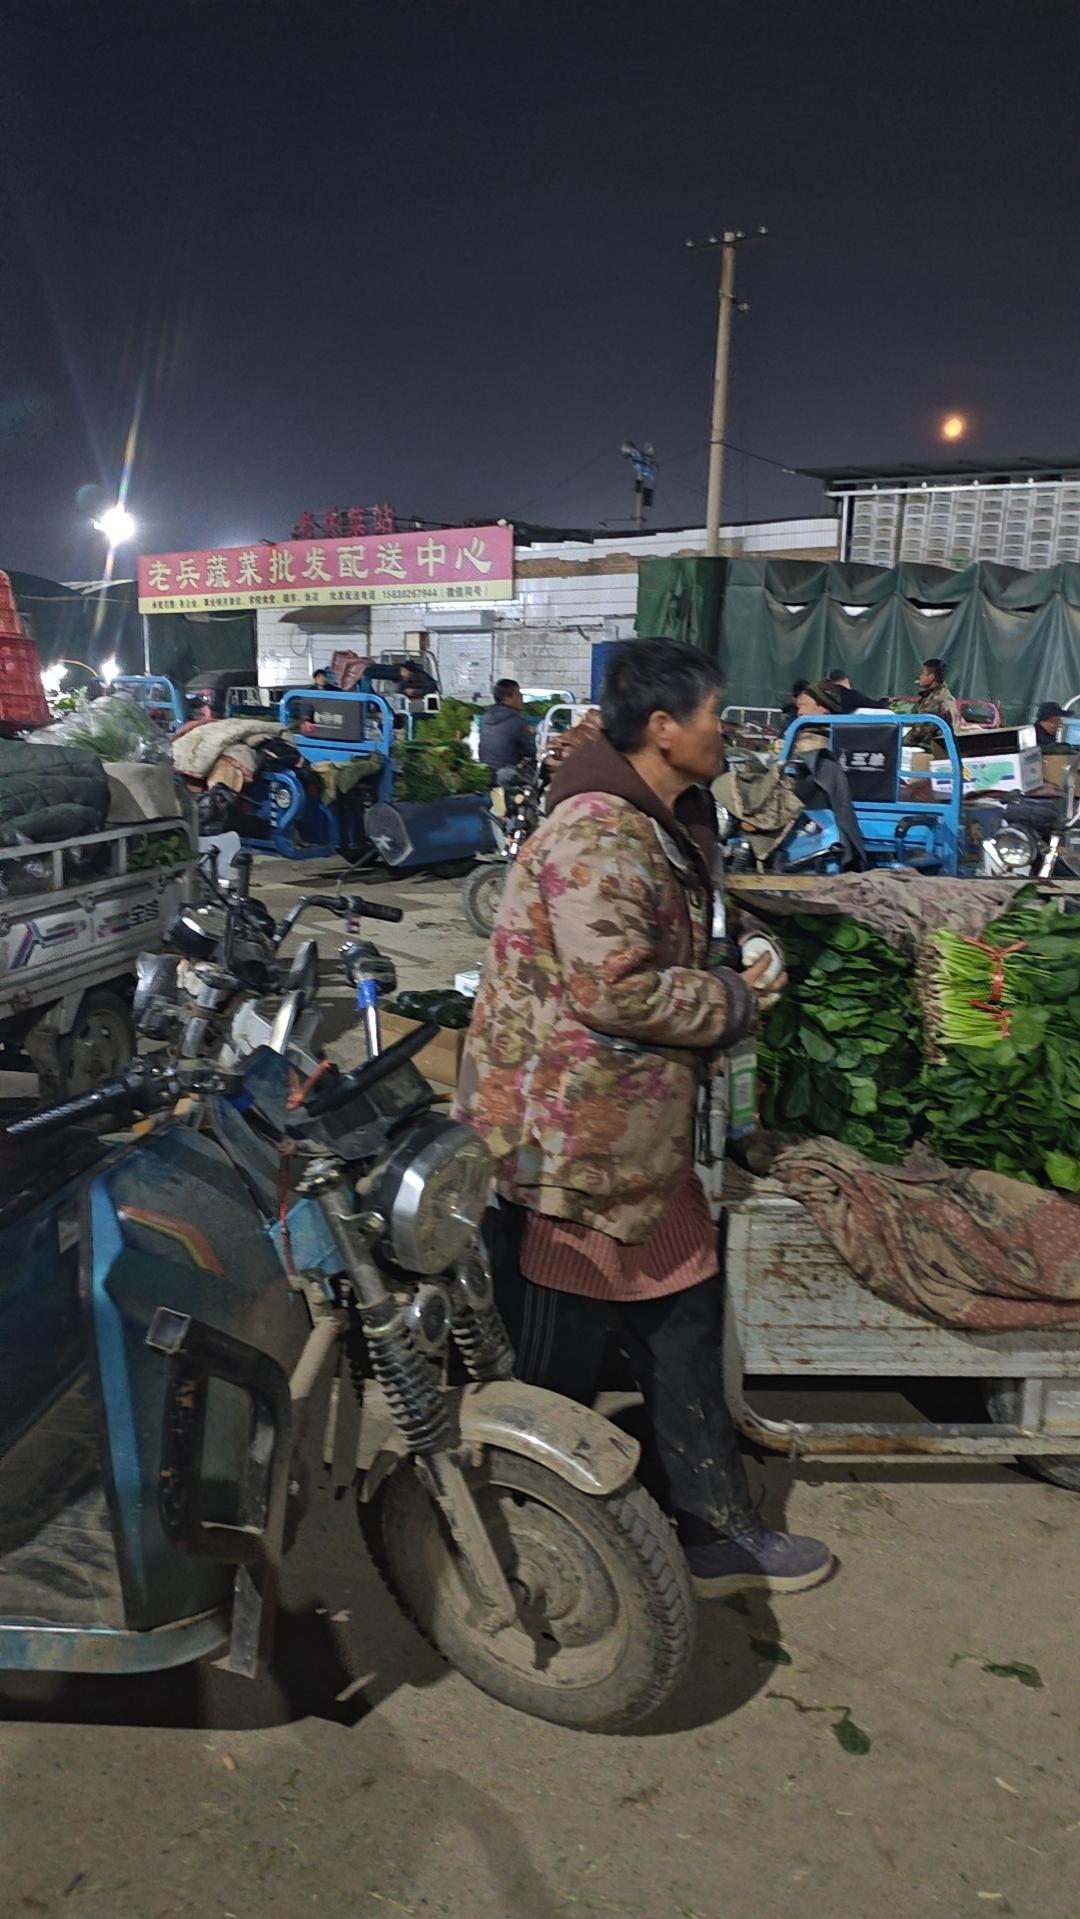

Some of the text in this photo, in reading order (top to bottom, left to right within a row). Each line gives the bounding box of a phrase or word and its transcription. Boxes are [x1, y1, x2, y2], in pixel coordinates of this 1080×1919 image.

[148, 537, 493, 591] 老兵蔬菜批发配送中心
